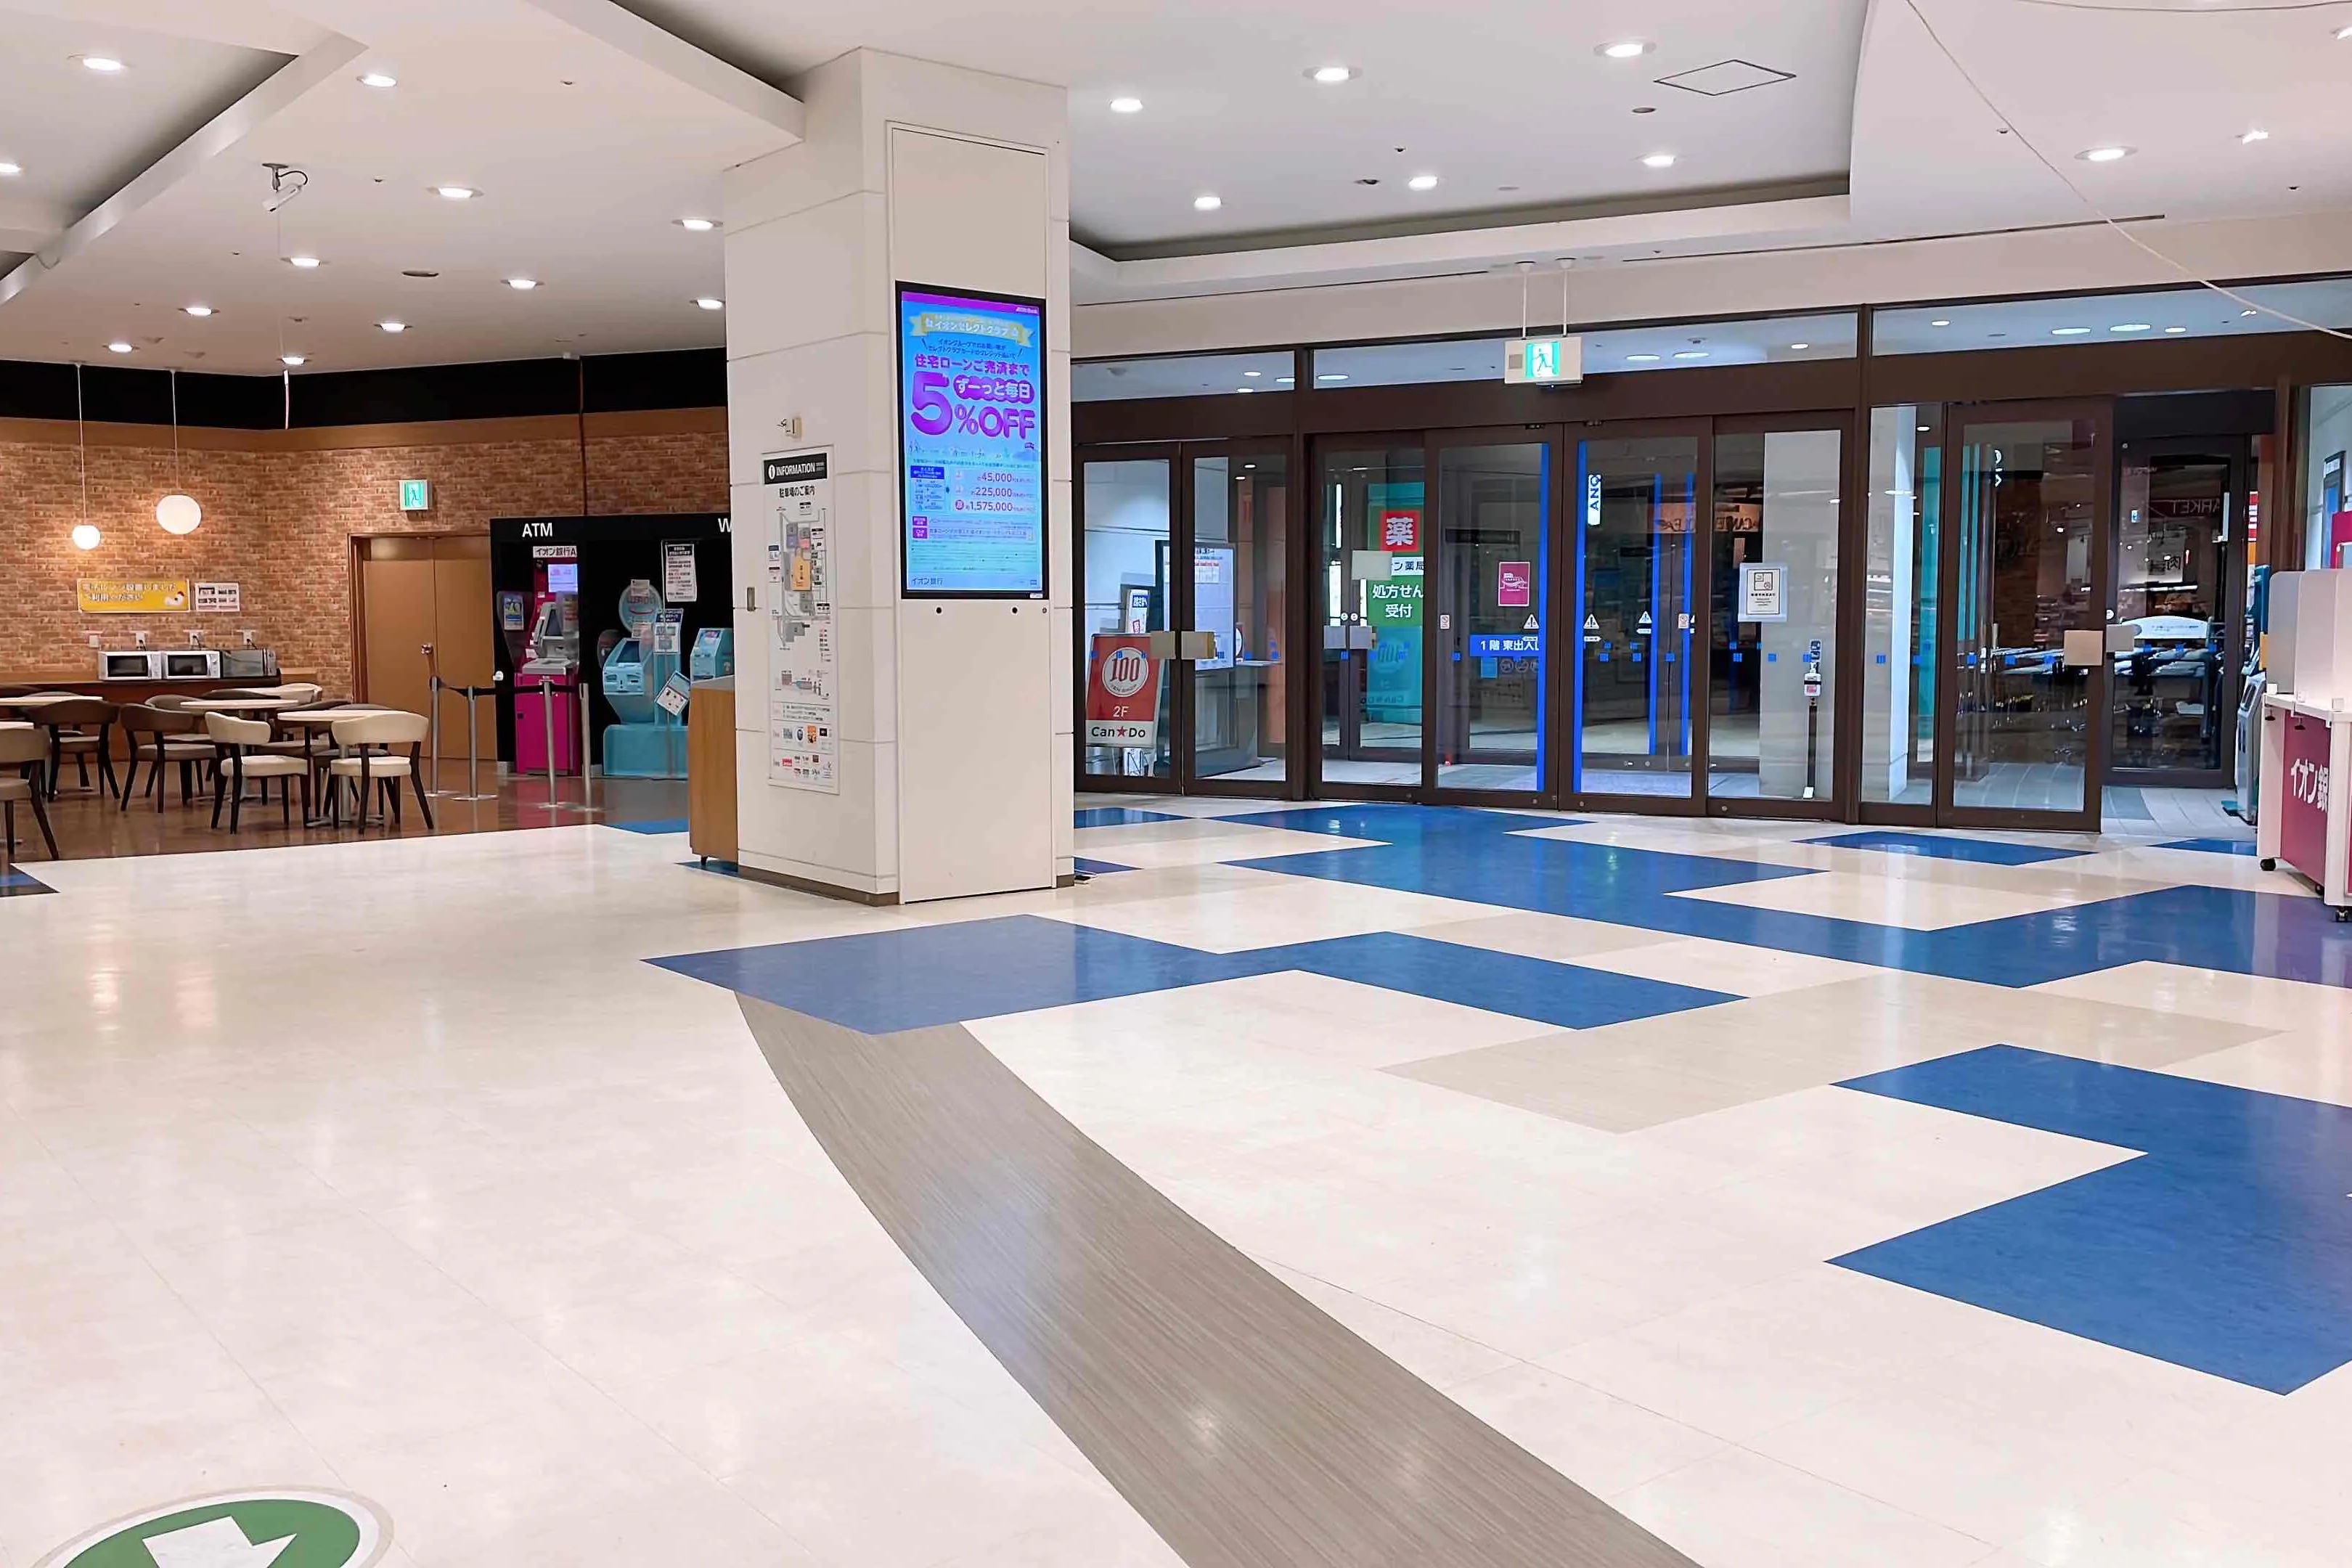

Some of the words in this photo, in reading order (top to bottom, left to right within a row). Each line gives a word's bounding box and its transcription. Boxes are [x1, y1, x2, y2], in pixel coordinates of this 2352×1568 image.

[915, 354, 1030, 377] 住宅ローンご完済まで
[956, 378, 1031, 399] ずーっと毎日
[776, 462, 816, 476] INFORMATION
[779, 486, 815, 498] 駐車場のご案内
[522, 522, 553, 537] ATM
[1385, 517, 1413, 546] 薬
[1392, 560, 1424, 572] ン薬局
[1372, 584, 1424, 598] 処方せん
[1385, 604, 1413, 618] 受付
[1109, 656, 1142, 682] 100
[1113, 706, 1129, 717] 2F
